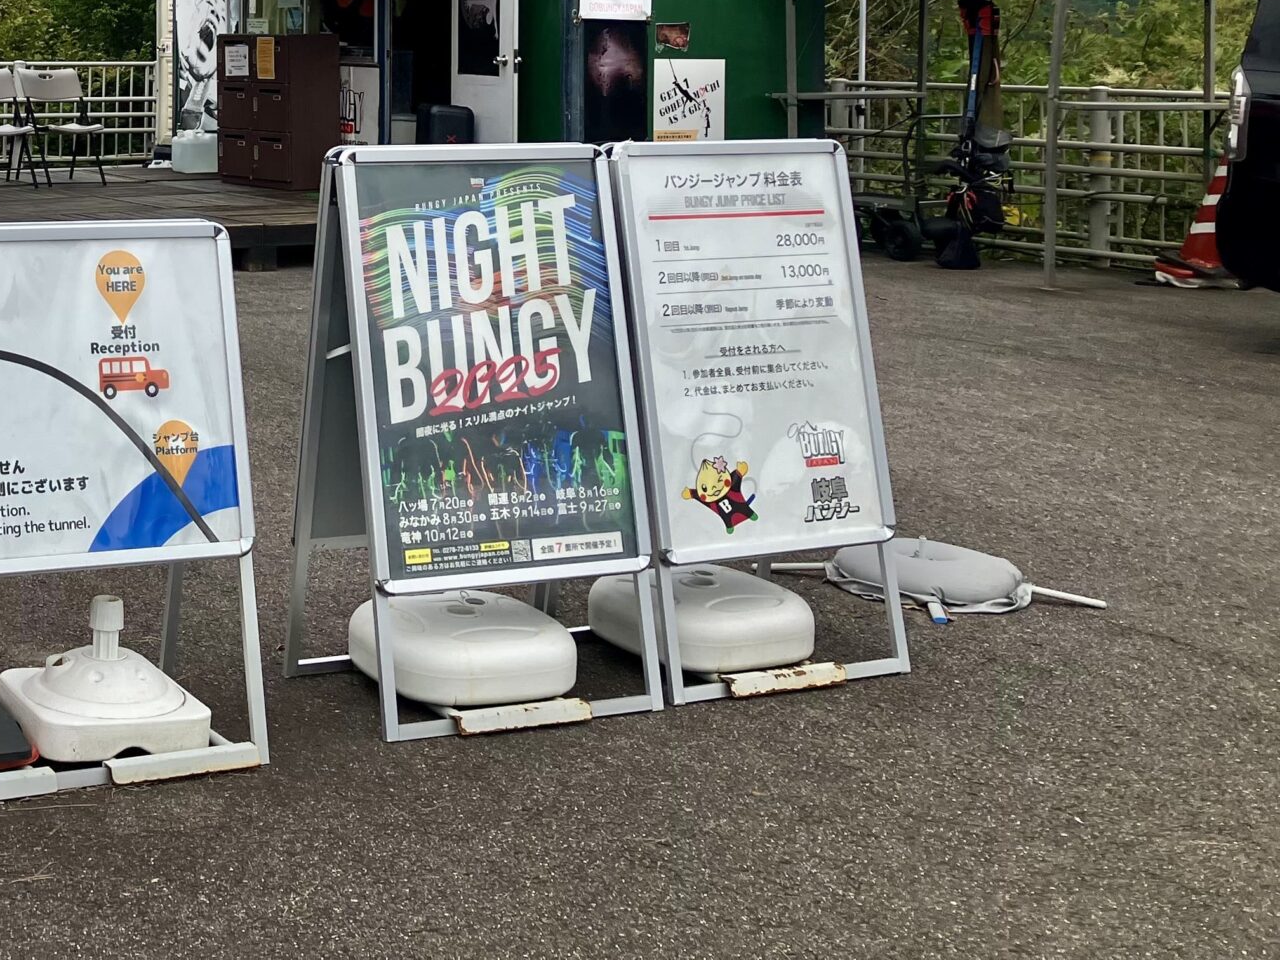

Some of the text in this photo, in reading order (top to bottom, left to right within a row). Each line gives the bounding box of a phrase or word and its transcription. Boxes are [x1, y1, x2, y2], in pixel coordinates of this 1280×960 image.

[415, 199, 446, 212] BUNGY
[453, 193, 484, 206] JAPAN
[489, 183, 542, 200] PRESENTS
[684, 193, 786, 208] BUNGY JUMP PRICE LIST
[385, 193, 577, 320] NIGHT
[98, 264, 143, 275] You are
[106, 280, 137, 292] HERE
[111, 325, 136, 340] 受付
[90, 340, 160, 356] Reception
[719, 344, 786, 358] 受付をされる方へ
[382, 288, 598, 425] BUNGY
[428, 347, 563, 417] 2025
[155, 445, 198, 456] Platform
[799, 429, 845, 464] BUNGY
[556, 487, 577, 500] 岐阜
[811, 476, 849, 503] 岐阜
[490, 507, 511, 520] 五木
[557, 502, 578, 515] 富士
[719, 499, 732, 513] B
[804, 502, 860, 523] バンジー
[24, 519, 46, 533] the
[48, 516, 92, 531] tunnel.
[399, 513, 441, 528] みなかみ
